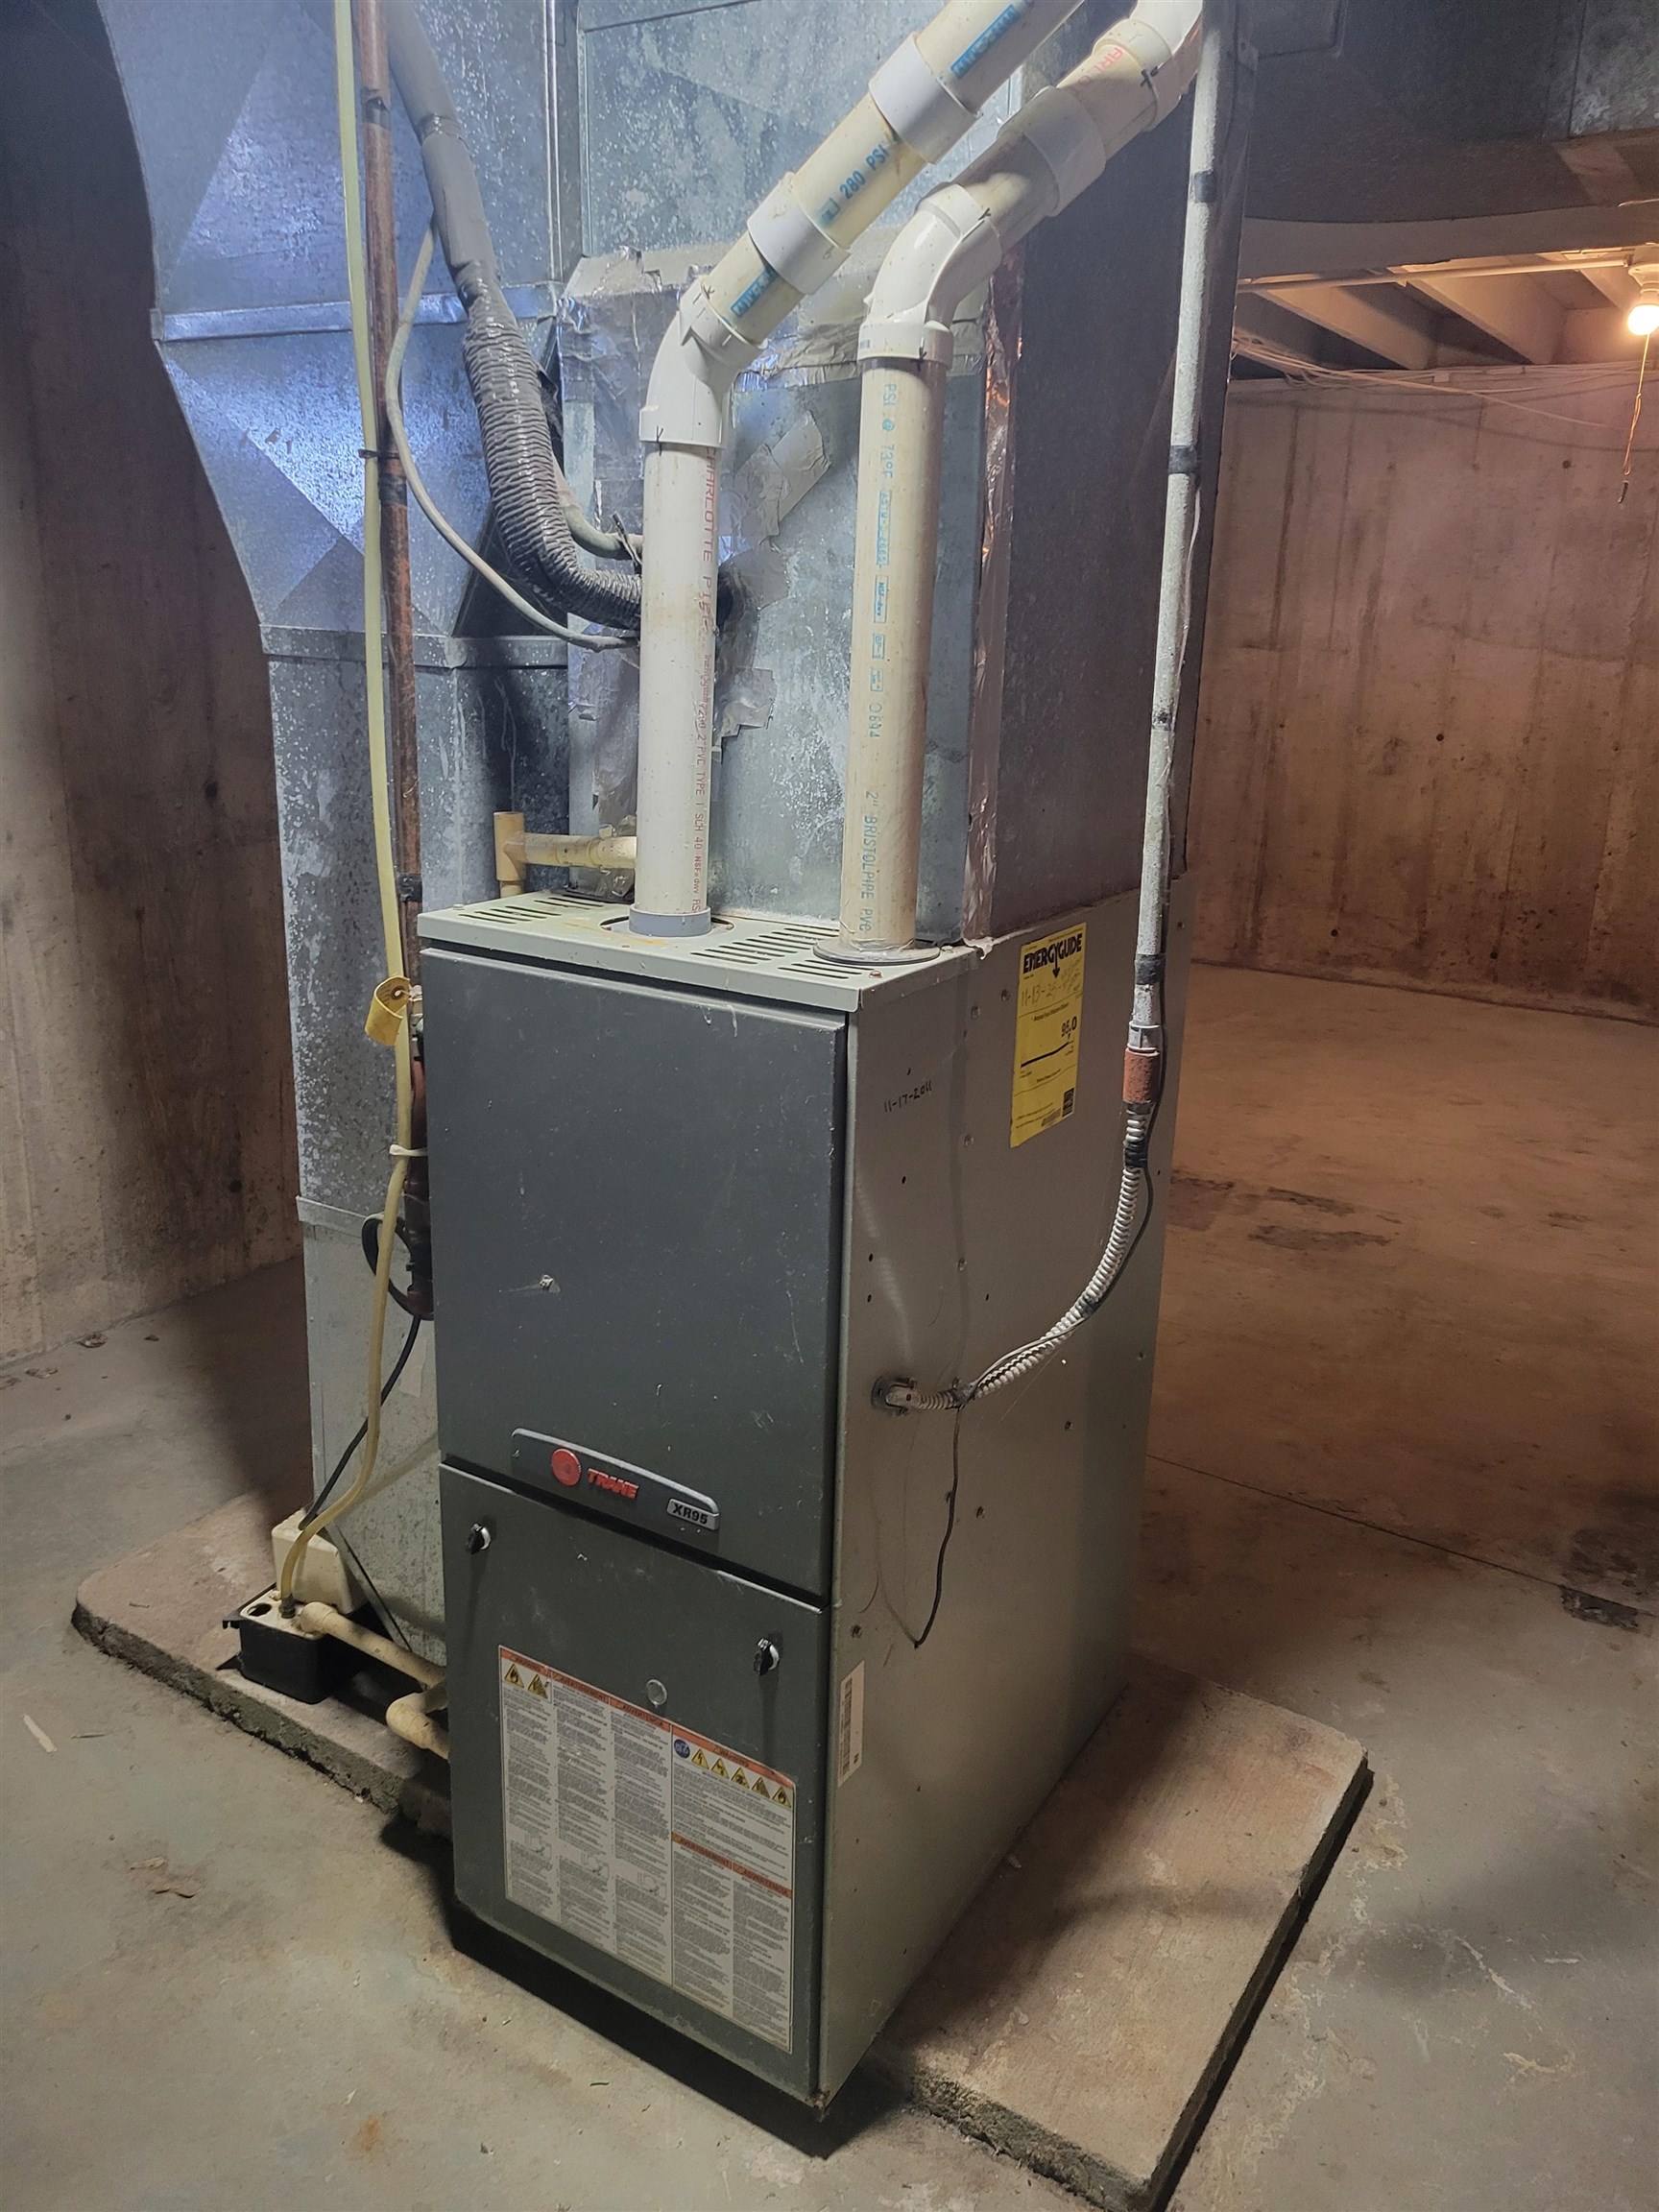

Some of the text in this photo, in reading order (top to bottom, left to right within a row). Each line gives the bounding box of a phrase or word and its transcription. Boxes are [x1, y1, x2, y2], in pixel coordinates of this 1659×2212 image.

[839, 143, 890, 200] 280 PSI
[882, 383, 898, 407] PSI
[696, 746, 706, 765] PVC
[695, 772, 706, 796] TYPE
[693, 836, 704, 850] 40
[1022, 932, 1083, 975] ENERGYGUIDE
[883, 1079, 933, 1114] 11-17-2011
[587, 1468, 639, 1500] TRANE
[672, 1502, 709, 1526] XR95
